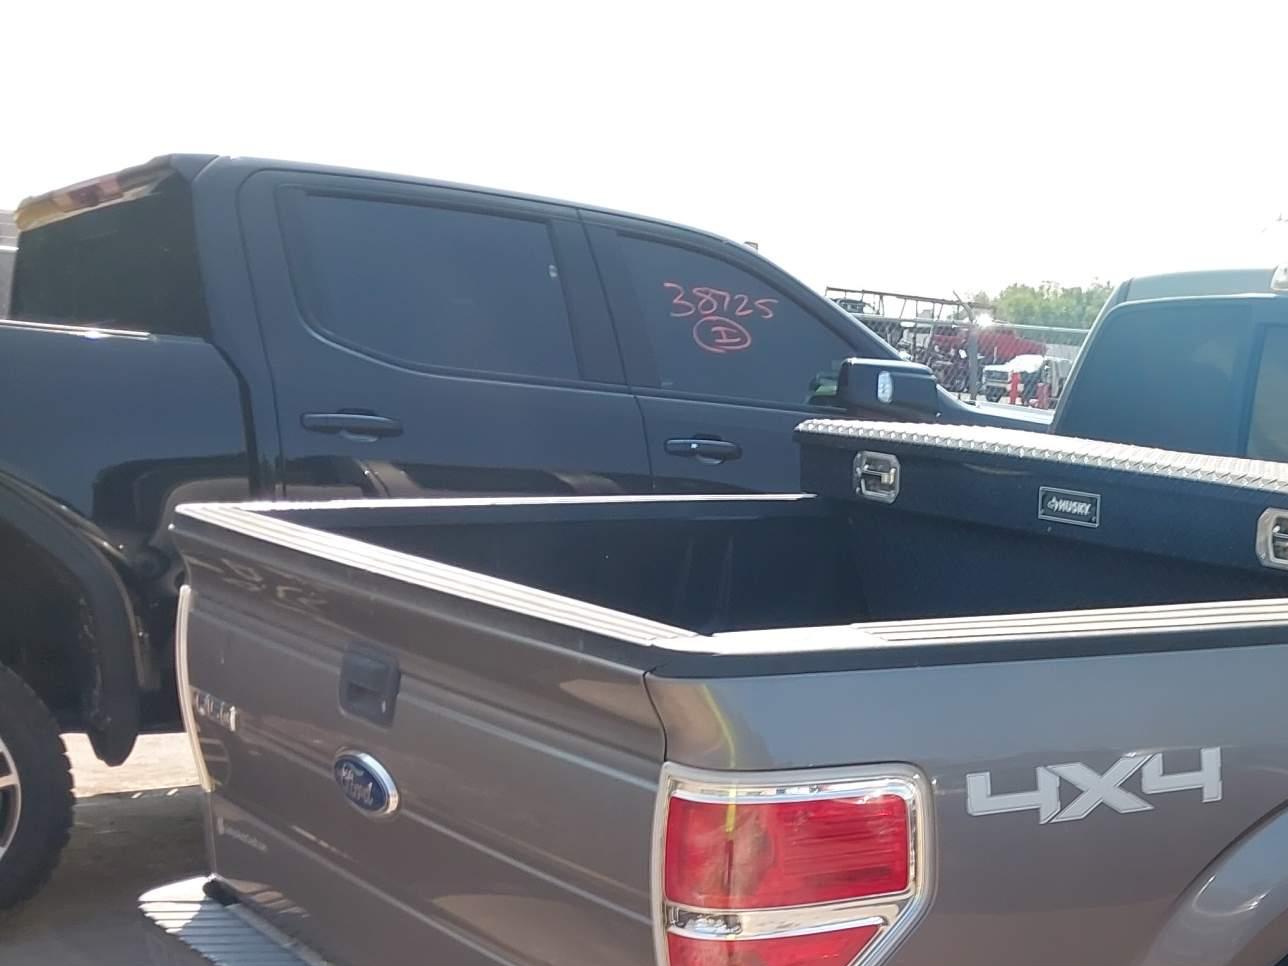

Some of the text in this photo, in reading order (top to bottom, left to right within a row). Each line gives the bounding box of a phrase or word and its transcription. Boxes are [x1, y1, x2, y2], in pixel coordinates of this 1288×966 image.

[663, 282, 779, 319] 38725
[1058, 499, 1091, 516] HUSKY
[966, 746, 1223, 824] 4X4
